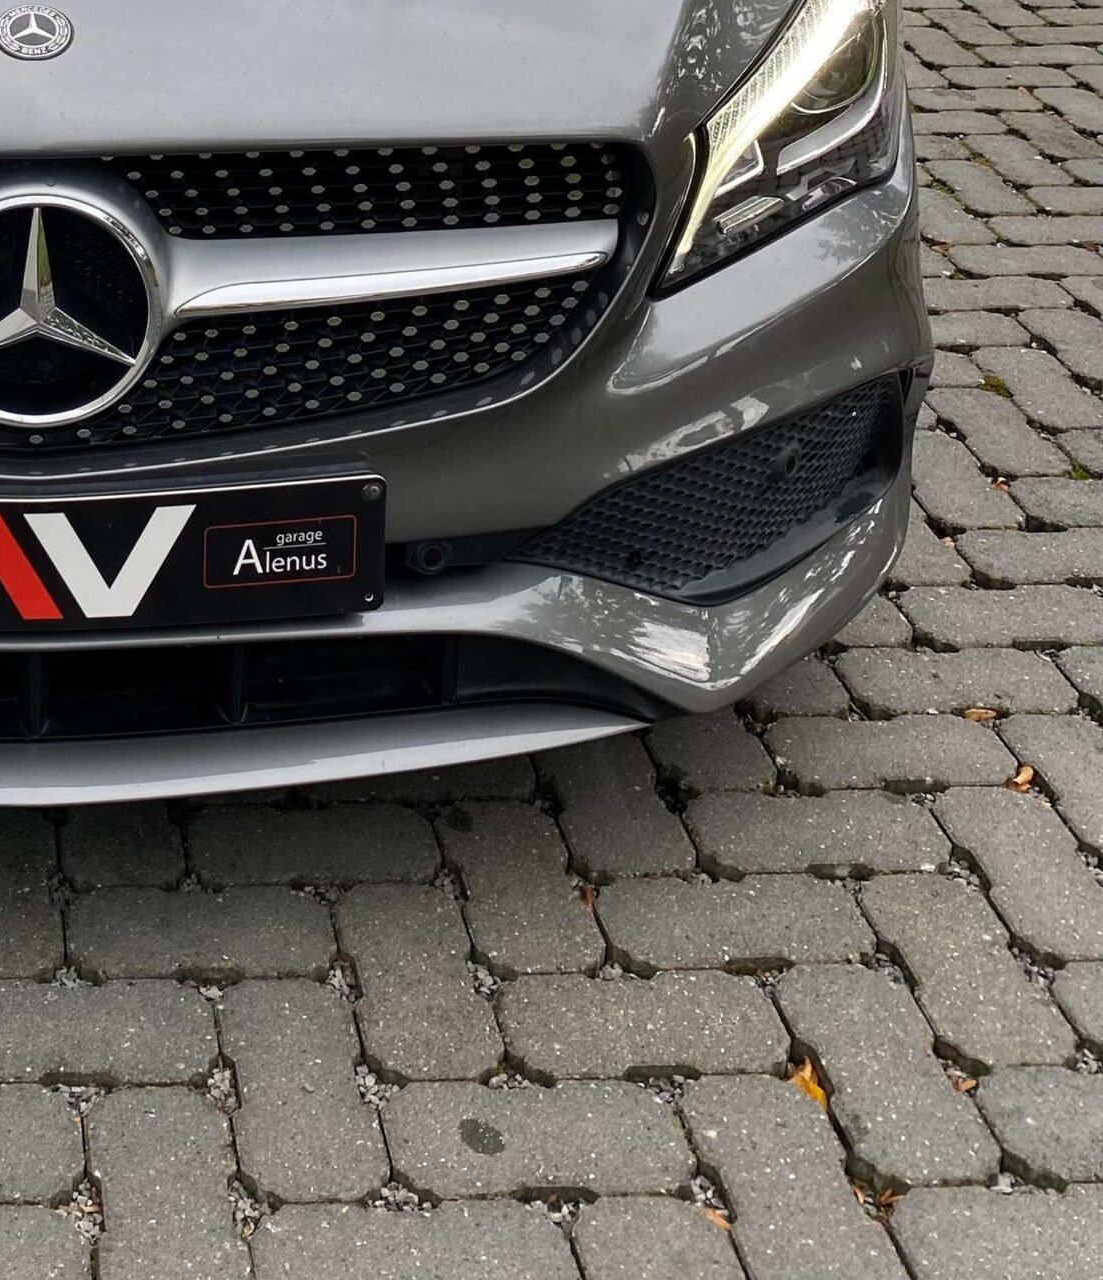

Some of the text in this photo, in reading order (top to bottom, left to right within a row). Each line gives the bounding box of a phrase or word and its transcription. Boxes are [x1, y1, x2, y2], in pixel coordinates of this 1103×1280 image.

[9, 6, 57, 17] MERCEDES
[21, 47, 48, 55] BENZ
[276, 530, 323, 547] garage
[232, 538, 327, 576] Alenus
